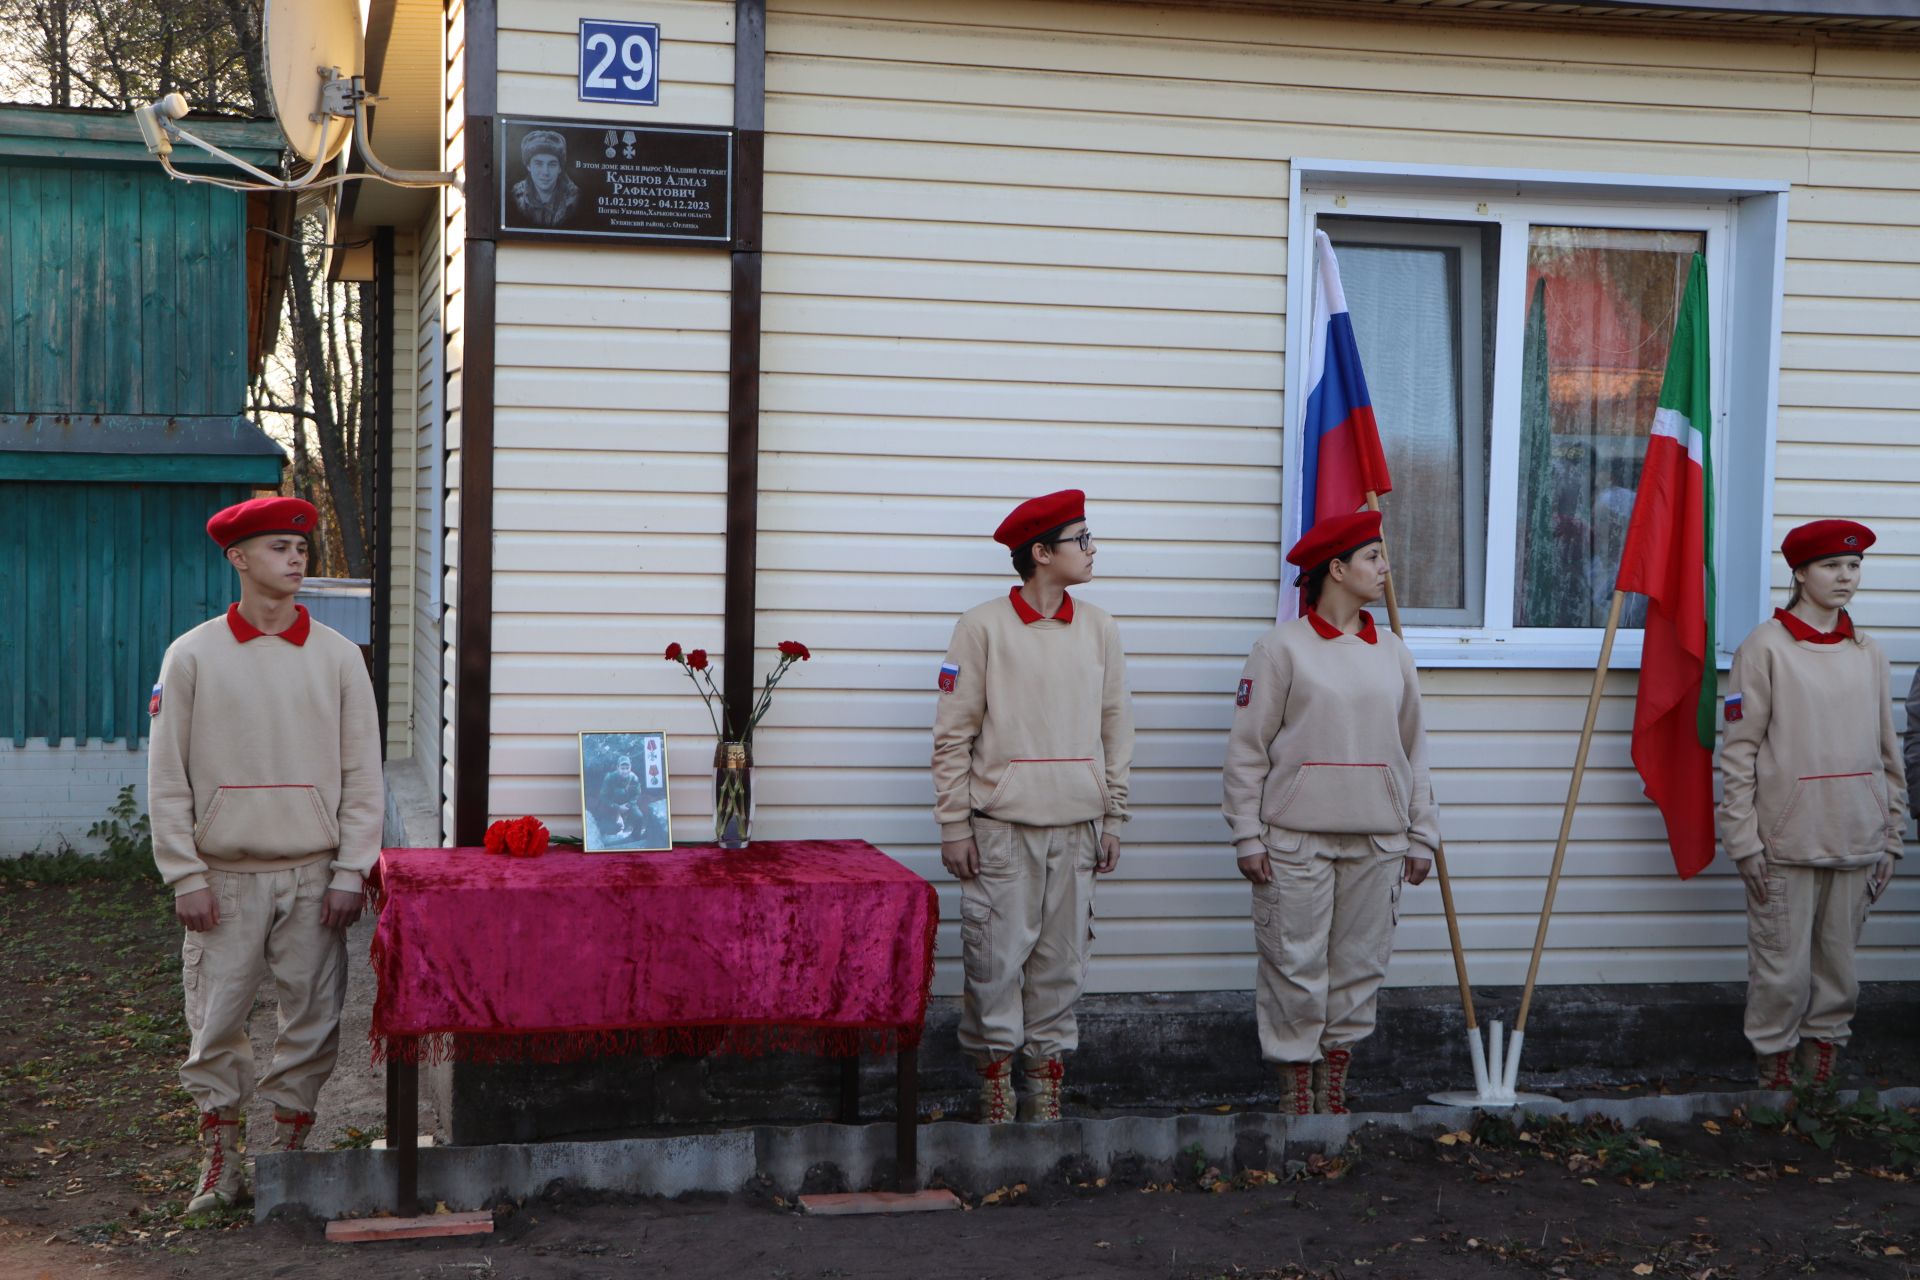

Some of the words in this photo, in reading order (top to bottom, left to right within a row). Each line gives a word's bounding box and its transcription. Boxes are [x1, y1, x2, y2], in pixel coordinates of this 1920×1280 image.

[586, 32, 653, 90] 29
[606, 172, 662, 184] КАБИРОВ
[666, 174, 707, 187] АЛМАЗ
[614, 183, 696, 198] РАФКАТОВИЧ
[598, 197, 650, 208] 01.02.1992
[658, 200, 710, 210] 04.12.2023
